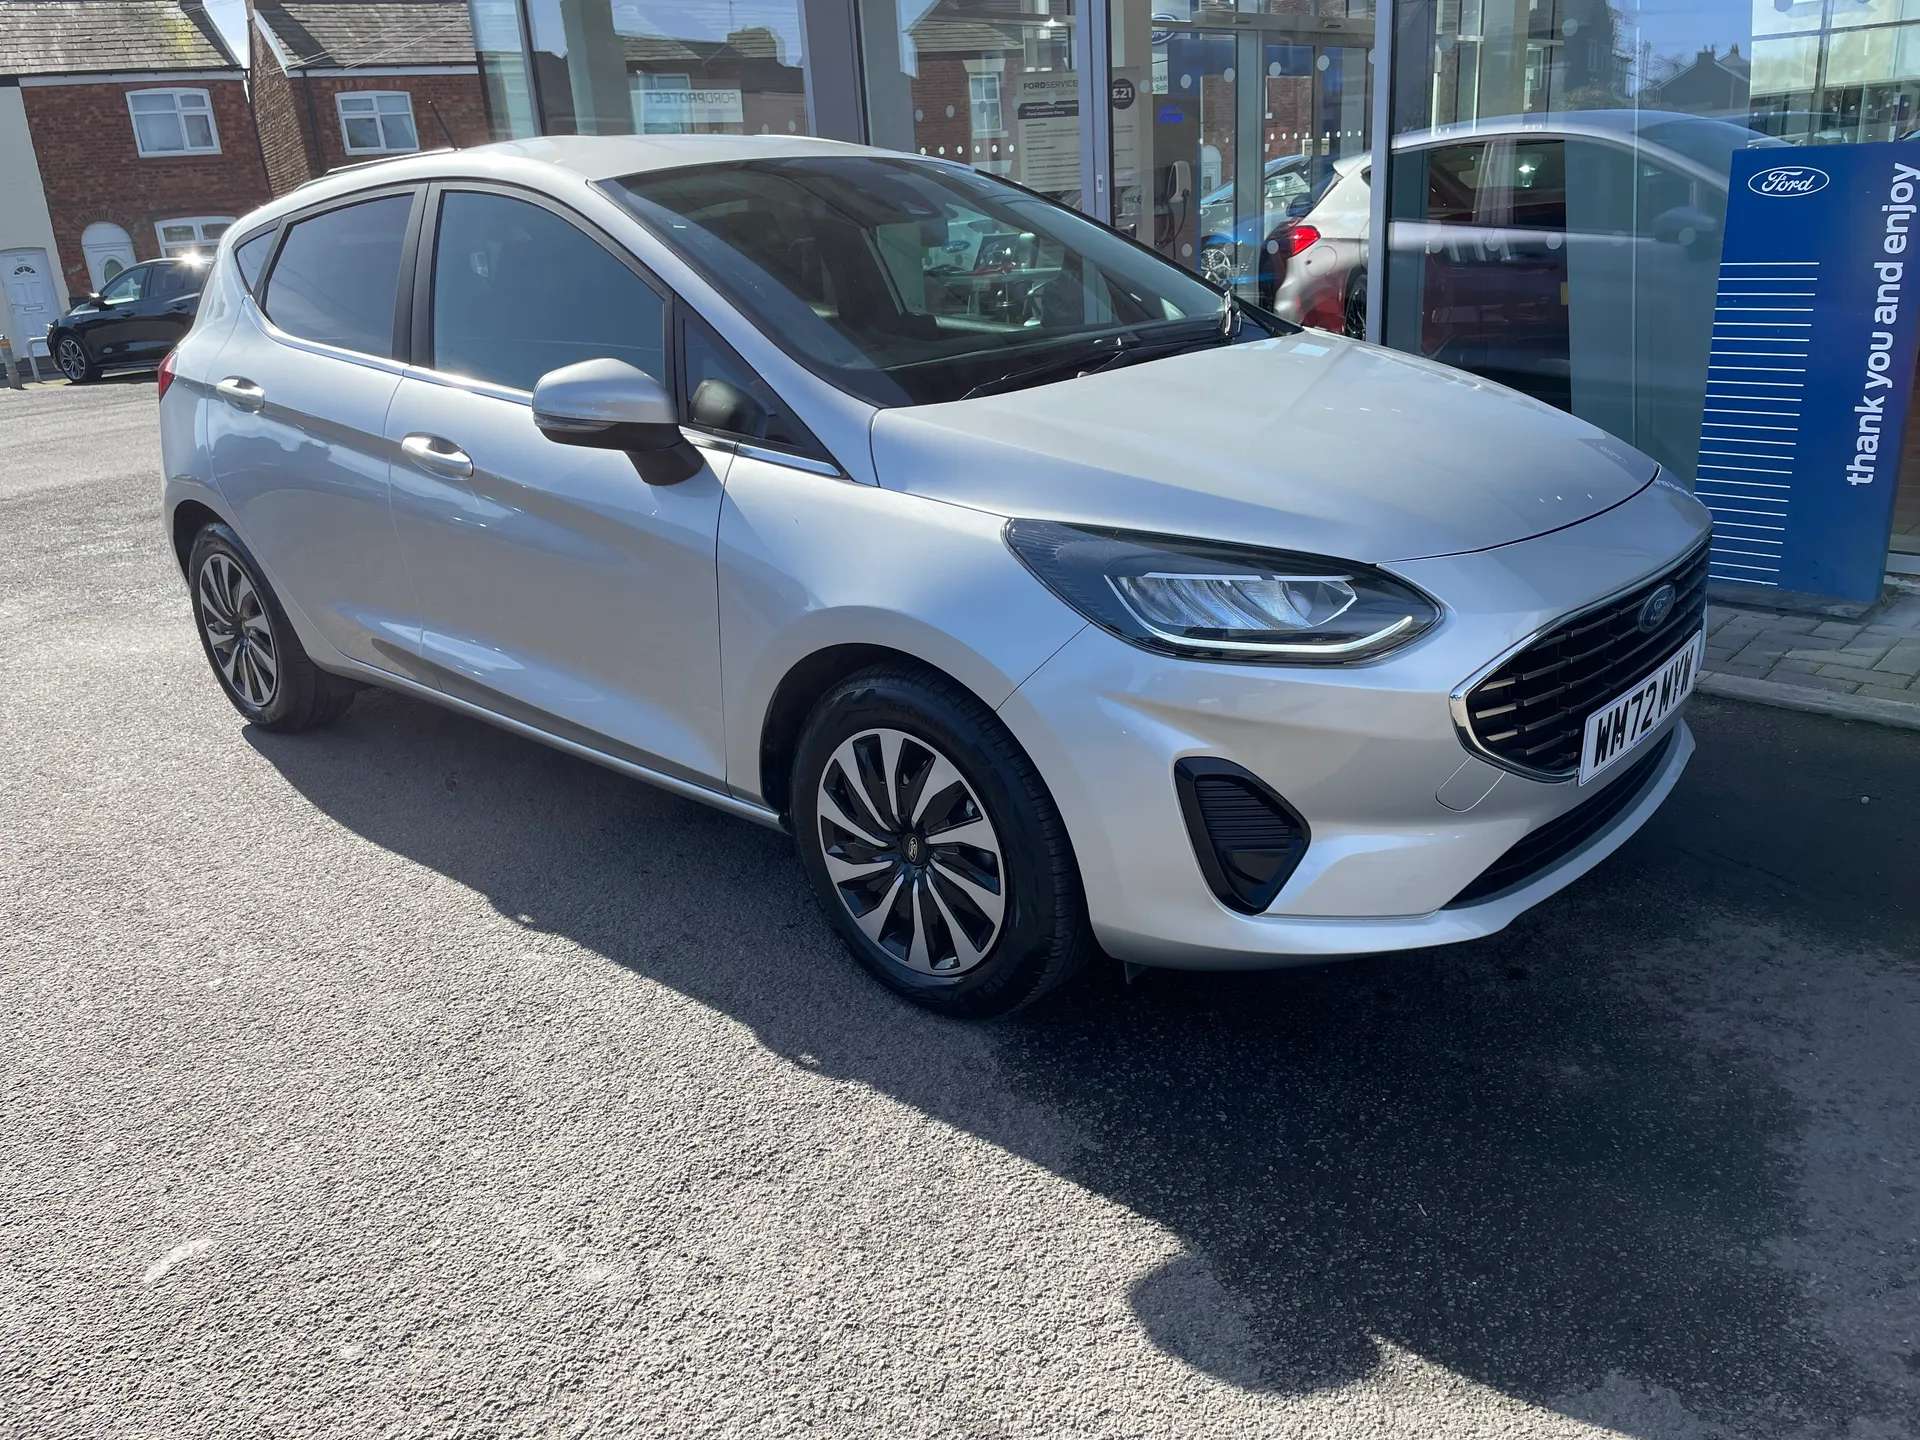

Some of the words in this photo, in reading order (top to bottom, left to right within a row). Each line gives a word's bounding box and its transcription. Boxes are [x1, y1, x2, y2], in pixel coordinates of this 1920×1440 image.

[1112, 87, 1132, 99] £21
[1760, 169, 1817, 193] Ford
[1882, 162, 1920, 254] enjoy
[1873, 262, 1903, 325] and
[1864, 331, 1894, 390] you
[1846, 394, 1885, 486] thank
[1593, 680, 1657, 768] WM72
